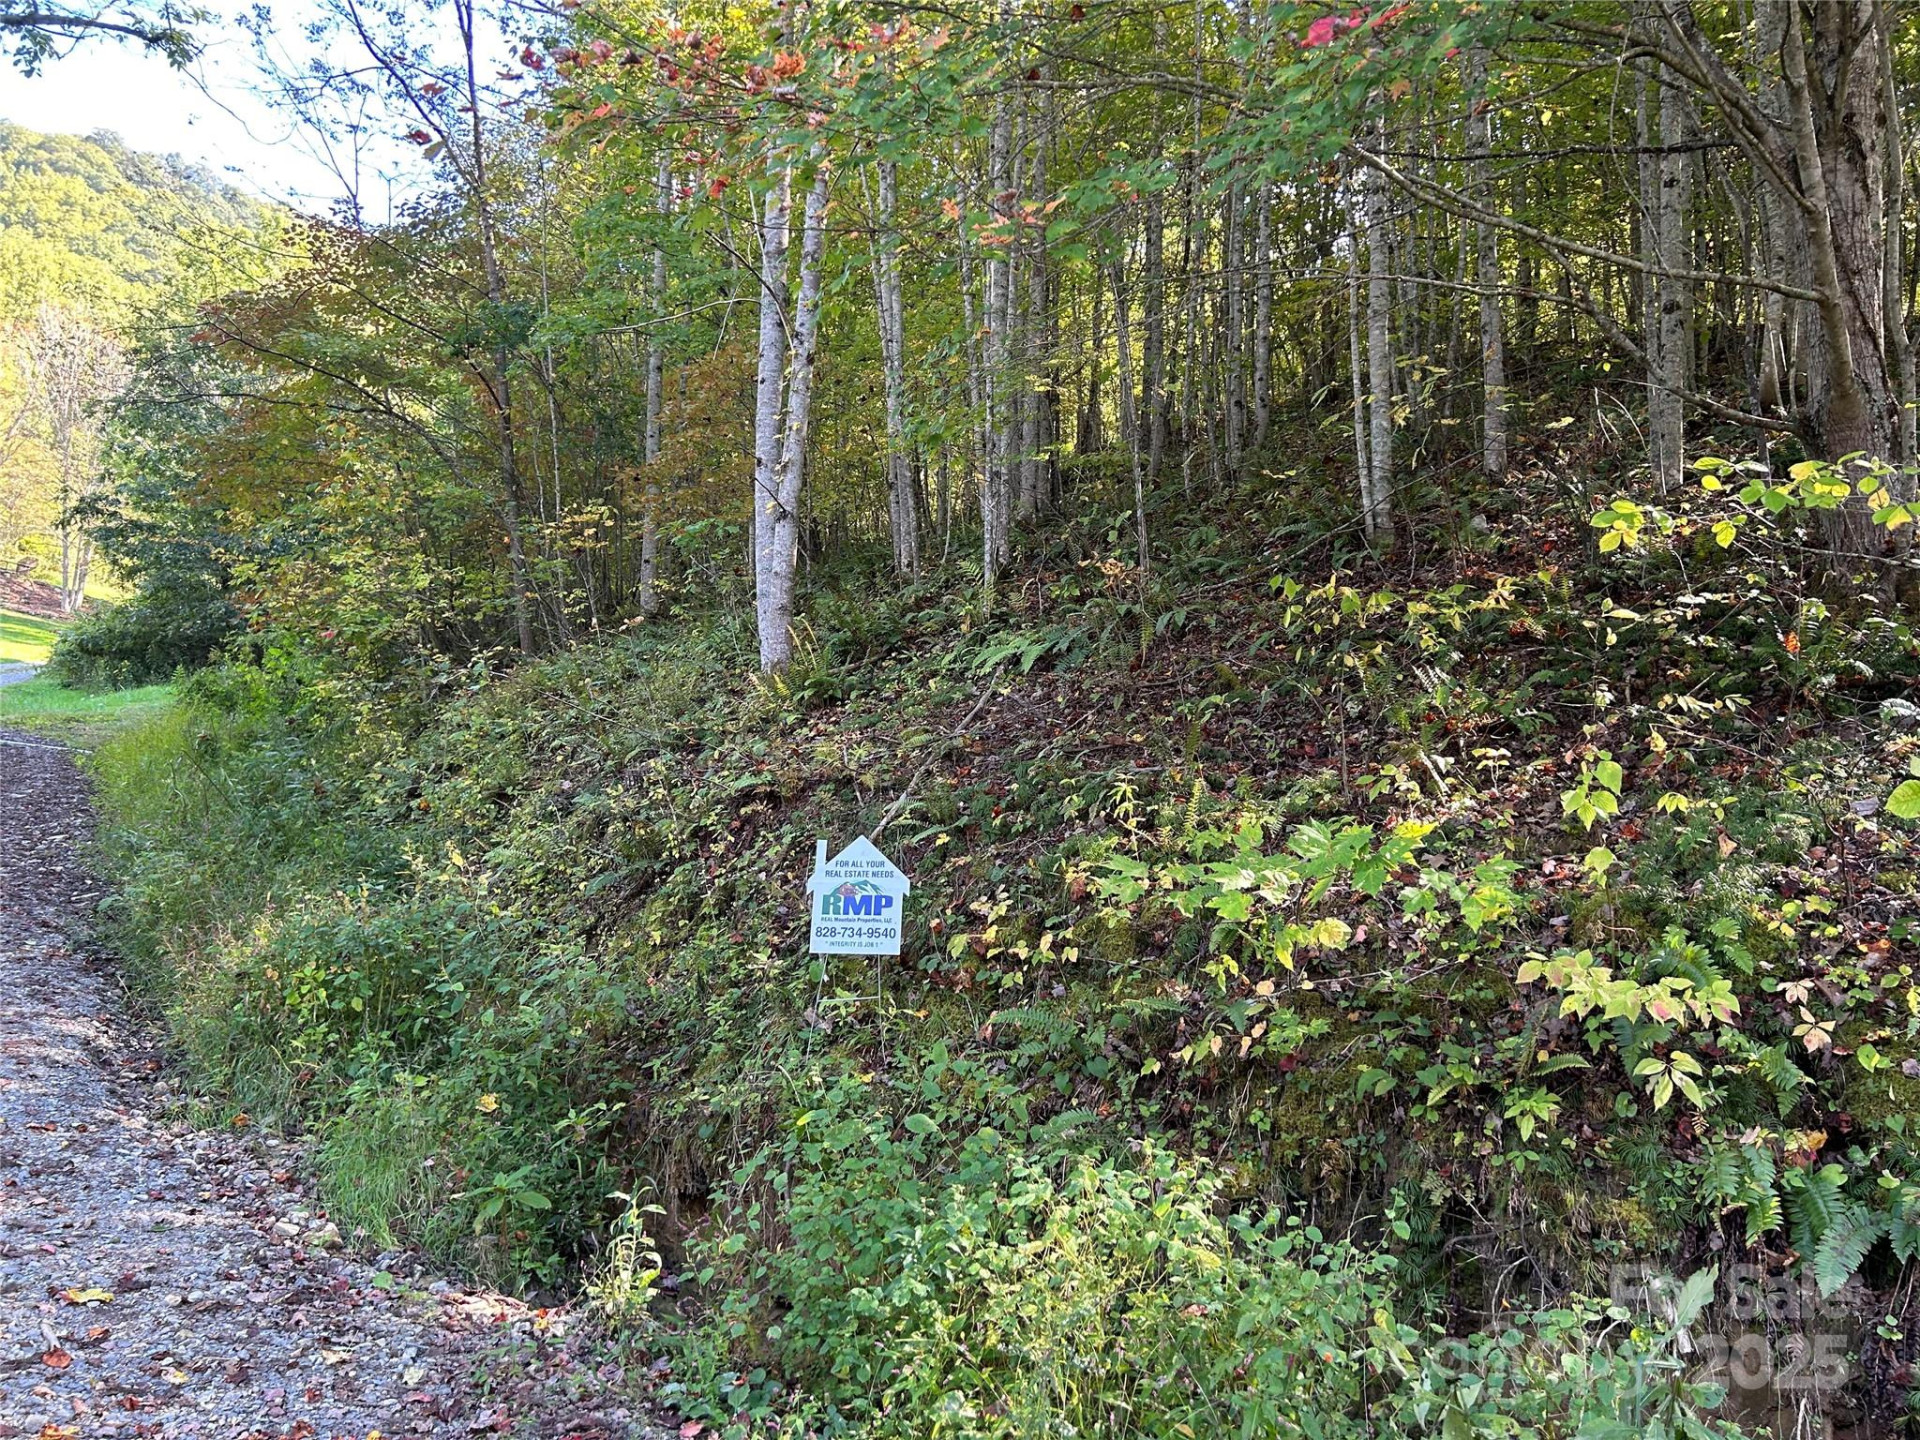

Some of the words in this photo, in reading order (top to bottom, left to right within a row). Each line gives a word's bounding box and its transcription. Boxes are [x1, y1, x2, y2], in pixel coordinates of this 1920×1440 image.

[835, 860, 849, 868] FOR
[851, 860, 863, 868] ALL
[866, 860, 885, 868] YOUR
[825, 870, 842, 878] REAL
[845, 870, 869, 878] ESTATE
[872, 870, 894, 878] NEEDS
[822, 894, 893, 916] RMP
[815, 926, 896, 939] 828-734-9540
